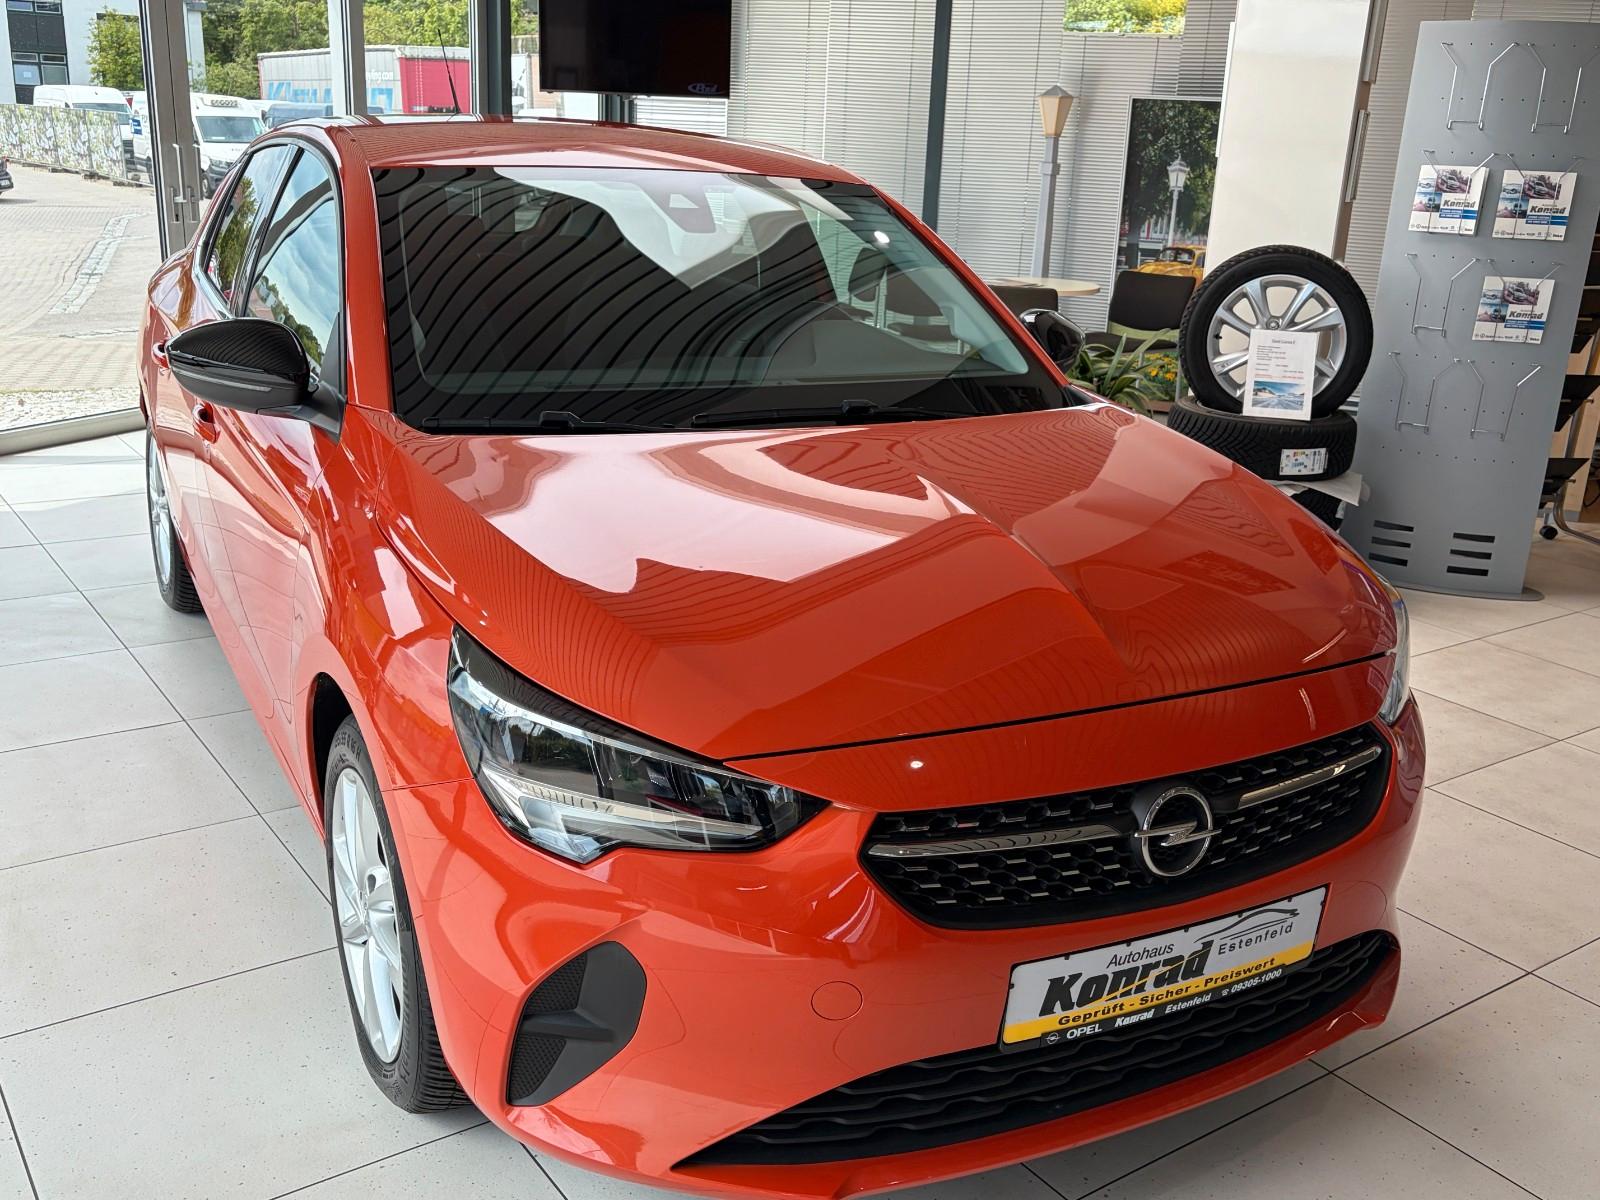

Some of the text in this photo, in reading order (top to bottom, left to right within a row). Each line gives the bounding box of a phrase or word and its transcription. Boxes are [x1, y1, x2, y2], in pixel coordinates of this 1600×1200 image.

[1508, 310, 1544, 320] Konrad
[1107, 943, 1174, 969] Autohaus
[1217, 921, 1294, 956] Estenfeld
[1039, 940, 1214, 1017] Konrad
[1058, 1001, 1125, 1026] Geprüft
[1139, 984, 1191, 1006] Sicher
[1203, 958, 1275, 988] Preiswert
[1066, 968, 1283, 1040] OPEL Konrad Estenfeld 09305-1000
